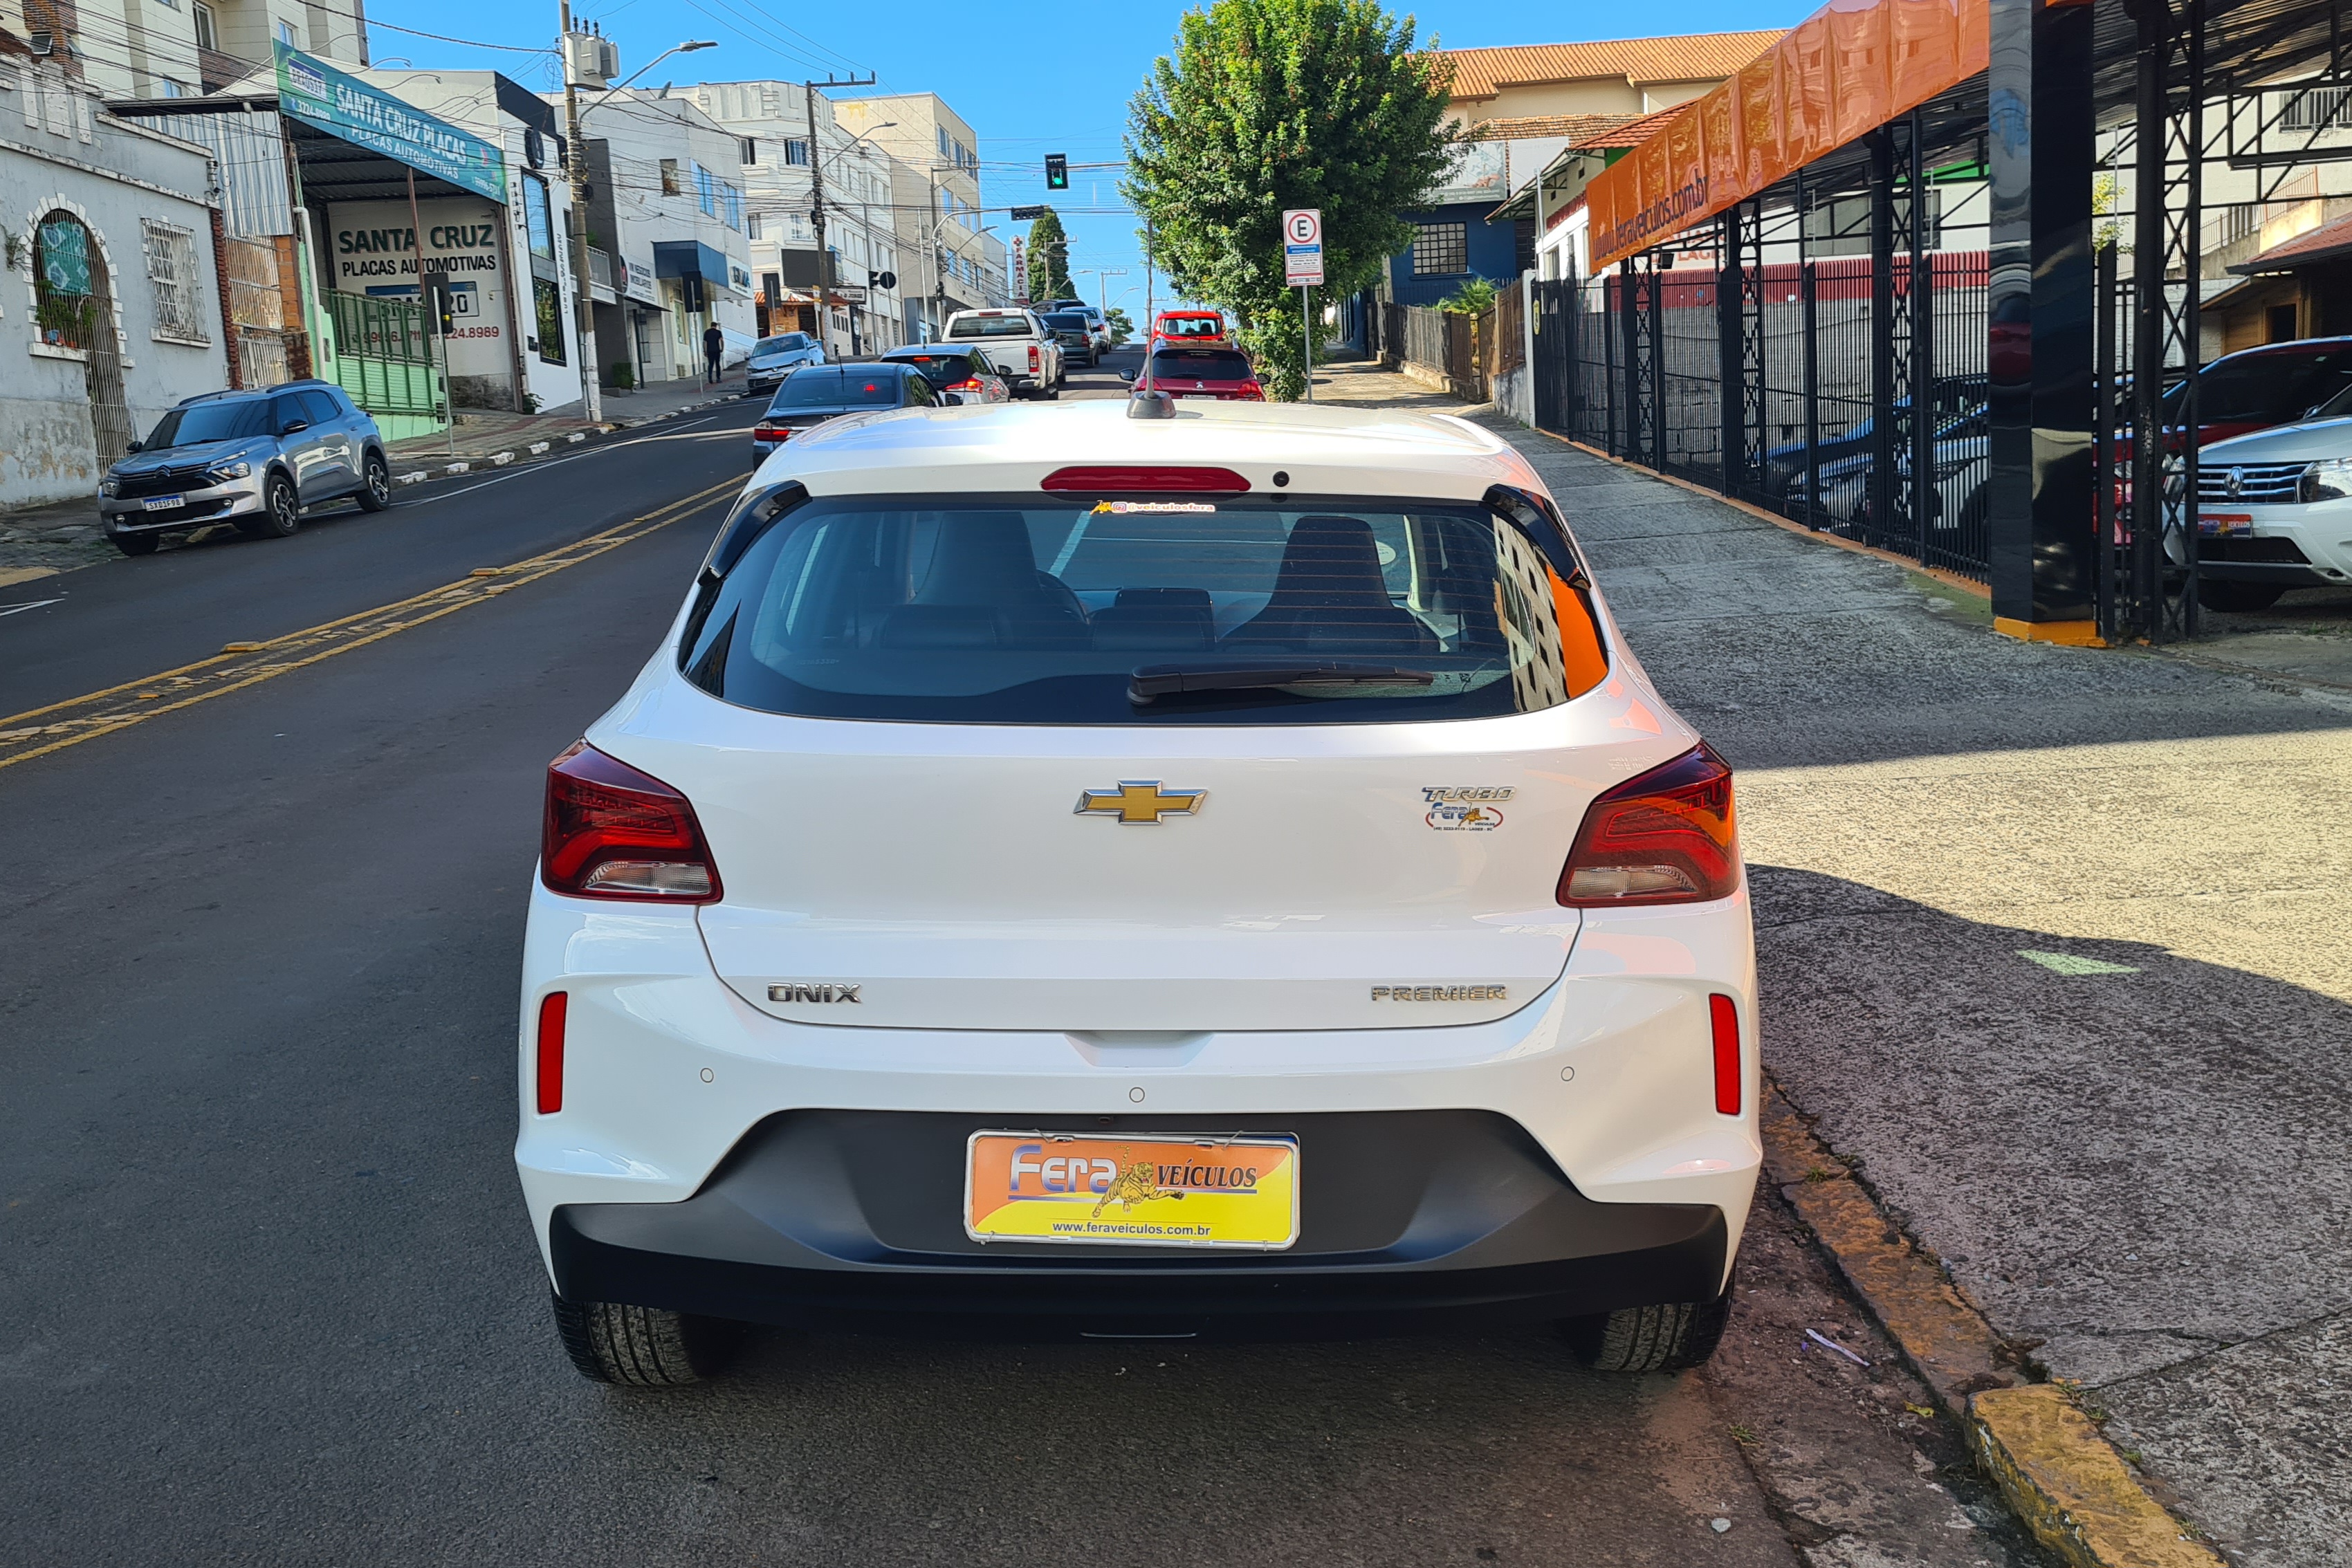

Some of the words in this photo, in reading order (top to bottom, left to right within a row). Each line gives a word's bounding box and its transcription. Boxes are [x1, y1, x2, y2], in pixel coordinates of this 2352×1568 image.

[336, 84, 383, 129] SANTA
[385, 107, 422, 143] CRUZ
[423, 124, 467, 165] PLACAS
[351, 124, 393, 151] PLACAS
[394, 142, 459, 179] AUTOMOTIVAS
[1296, 219, 1308, 237] E
[339, 228, 421, 254] SANTA
[430, 224, 495, 248] CRUZ
[342, 259, 396, 277] PLACAS
[401, 255, 496, 274] AUTOMOTIVAS
[1128, 502, 1215, 513] @veiculosfera
[1422, 786, 1516, 802] TURBO
[1431, 802, 1468, 819] Fera
[767, 983, 861, 1003] ONIX
[1372, 985, 1506, 1001] PREMIER
[1010, 1144, 1117, 1194] Fera
[1157, 1159, 1258, 1188] VEÍCULOS
[1052, 1221, 1211, 1236] www.feraveiculos.com.br
